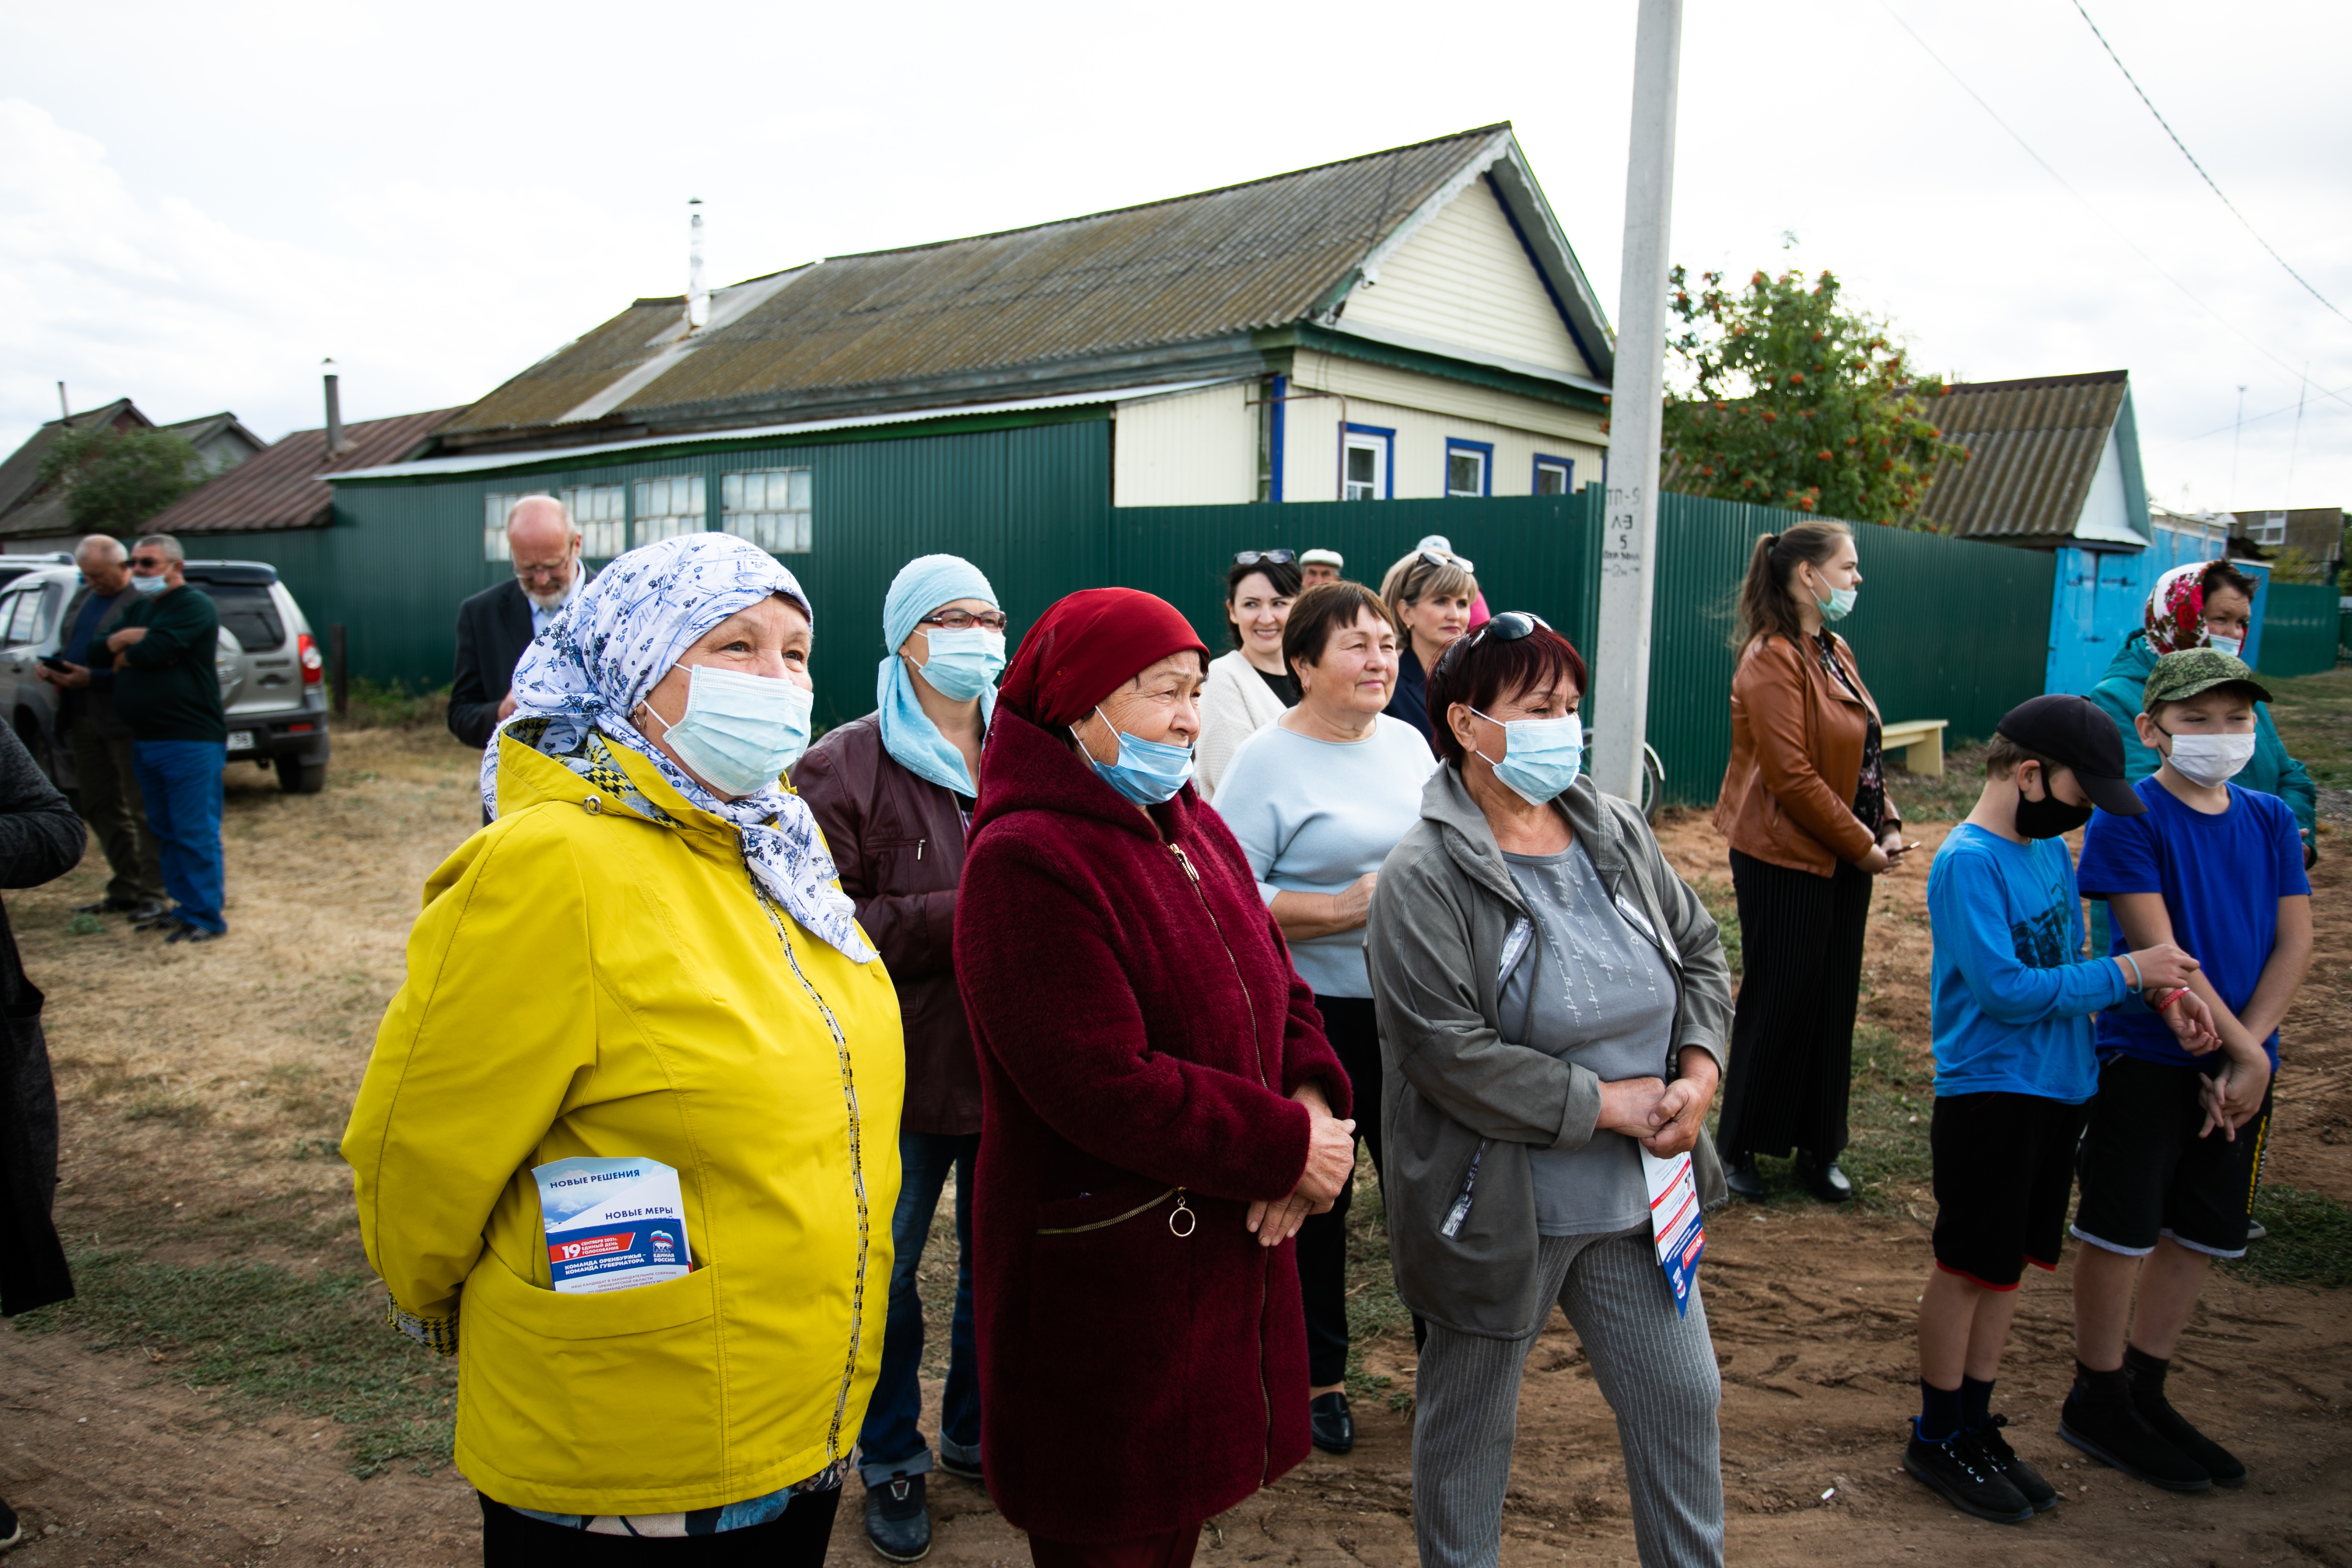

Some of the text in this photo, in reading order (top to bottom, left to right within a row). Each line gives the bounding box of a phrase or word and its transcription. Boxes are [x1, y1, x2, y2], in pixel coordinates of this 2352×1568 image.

[1619, 534, 1627, 549] 5
[794, 848, 803, 863] Türkiy
[550, 1169, 640, 1188] НОВЫЕ РЕШЕНИЯ
[605, 1209, 643, 1220] НОВЫЕ
[1696, 1234, 1703, 1248] 19
[562, 1244, 581, 1259] 19
[582, 1246, 619, 1255] ГОЛОСОВАНИЯ
[565, 1260, 598, 1270] КОМАНДА
[599, 1253, 642, 1264] ОРЕНБУРЖЬЯ
[566, 1258, 644, 1275] КОМАНДА ГУБЕРНАТОРА
[598, 1279, 632, 1288] ОРЕНБУРГСКОЙ
[611, 1272, 654, 1282] ЗАКОНОДАТЕЛЬНОЕ
[595, 1283, 638, 1293] ОДНОМАНДАТНОМУ
